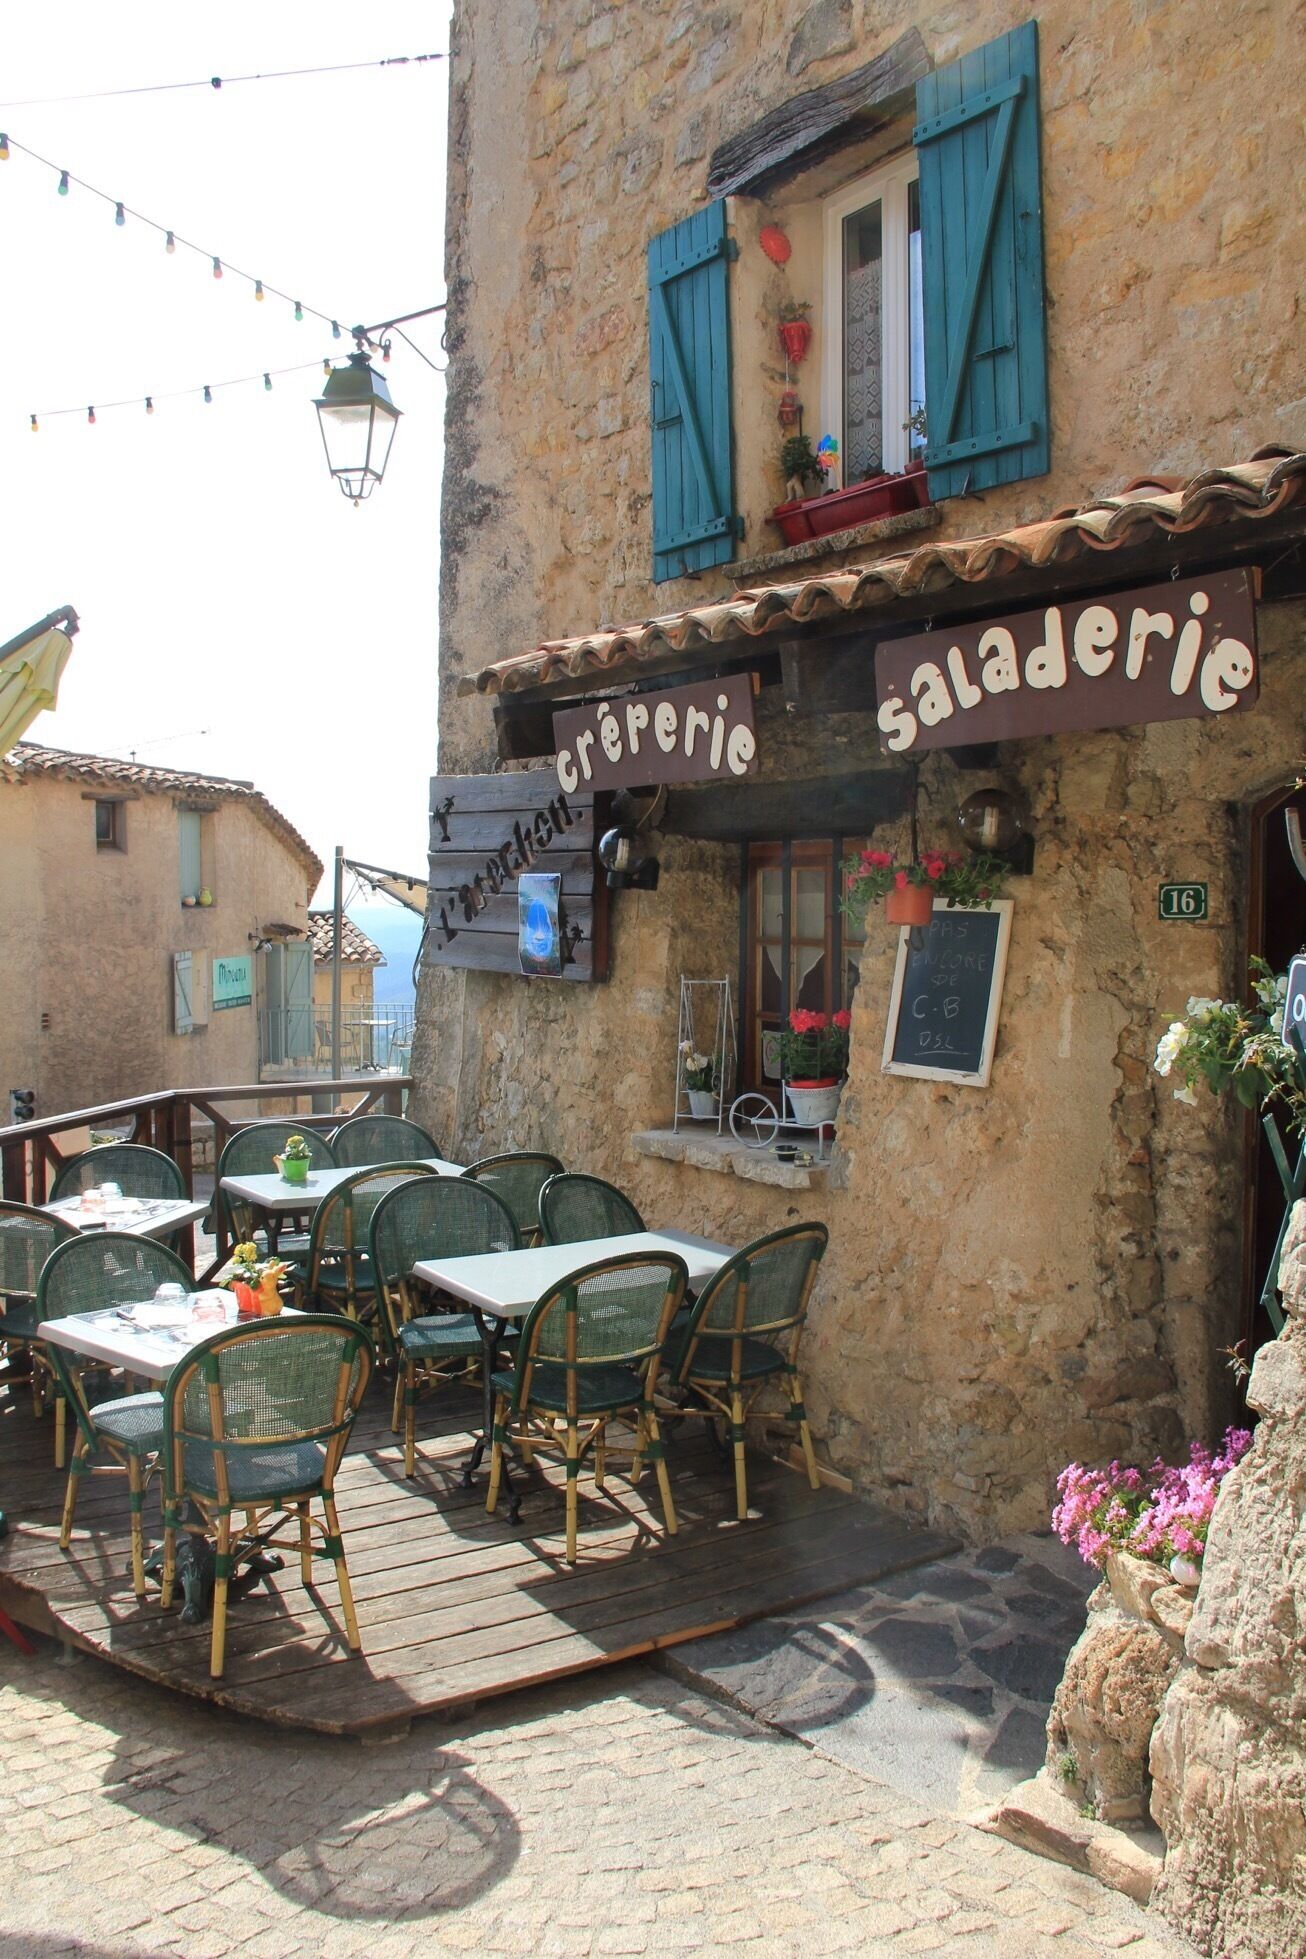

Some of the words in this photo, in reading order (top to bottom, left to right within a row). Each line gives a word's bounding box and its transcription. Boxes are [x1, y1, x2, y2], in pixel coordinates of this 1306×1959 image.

[877, 591, 1254, 752] saladerie
[556, 694, 756, 794] crêperie
[1170, 890, 1196, 913] 16
[929, 920, 969, 938] PAS
[912, 950, 987, 972] ENCORE
[931, 974, 959, 987] DE
